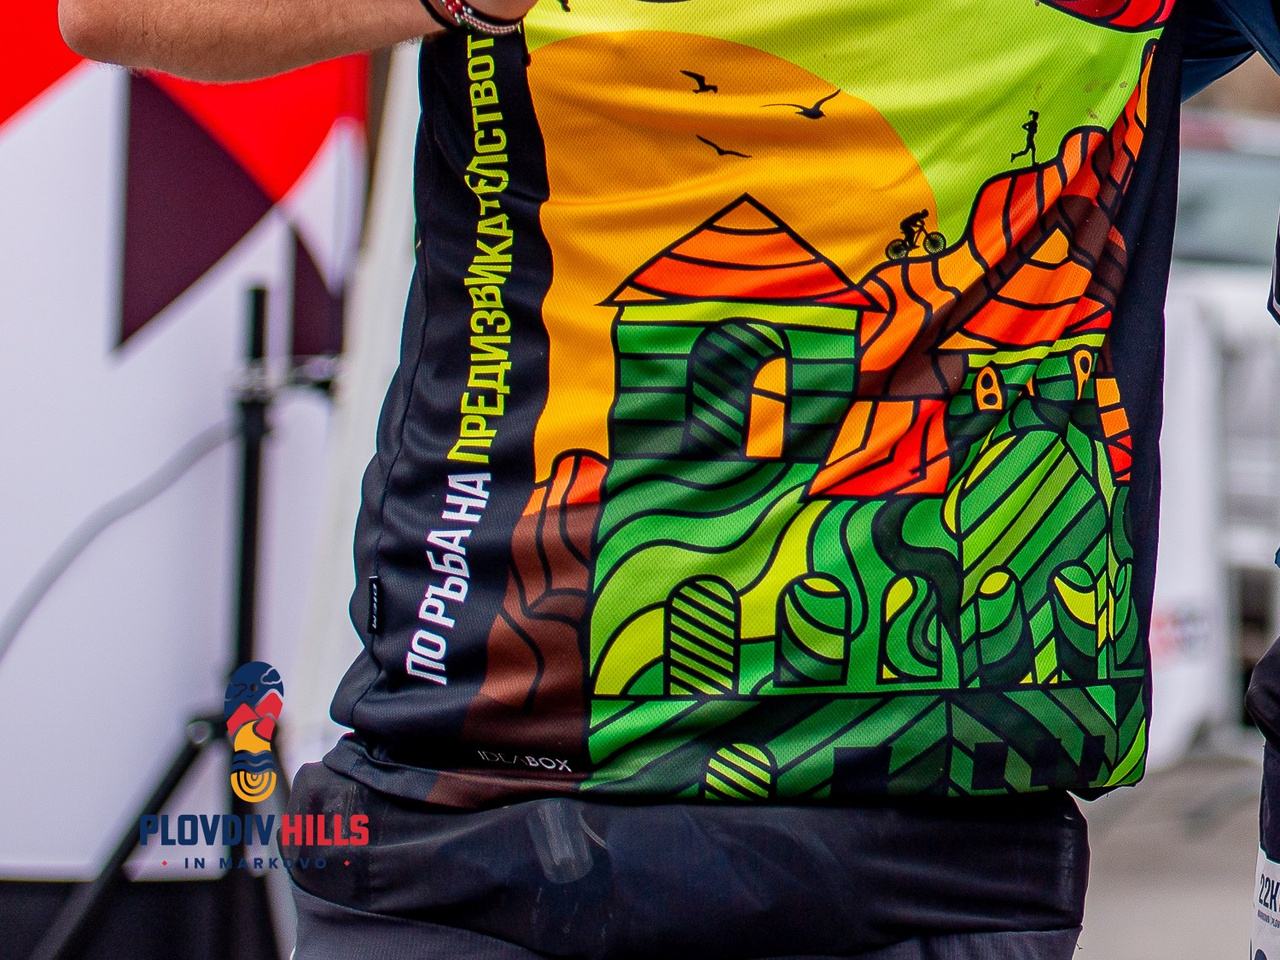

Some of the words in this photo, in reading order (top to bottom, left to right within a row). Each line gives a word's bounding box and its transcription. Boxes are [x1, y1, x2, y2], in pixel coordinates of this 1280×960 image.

[446, 34, 513, 464] ПРЕДИЗВИКАТЕЛСТВОТ
[441, 472, 492, 523] НА
[418, 529, 473, 629] РЪБА
[406, 629, 448, 686] ПО
[1258, 873, 1280, 913] 22K
